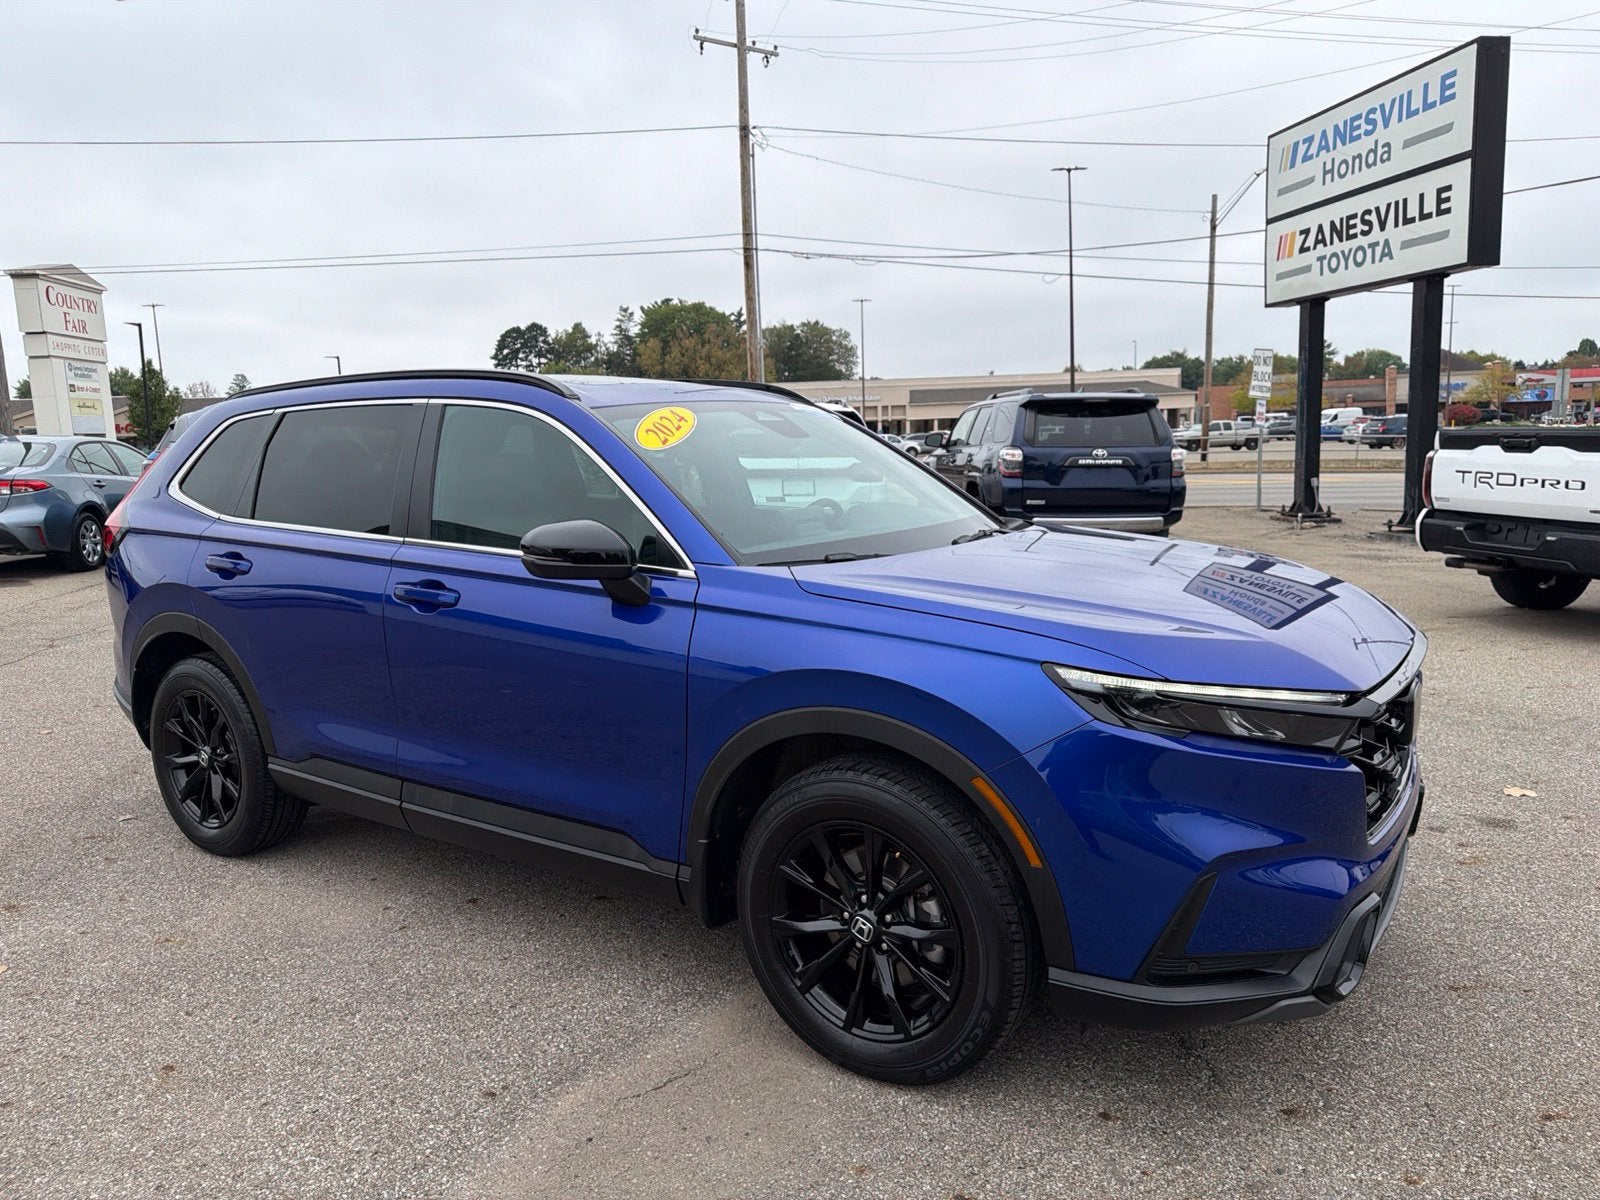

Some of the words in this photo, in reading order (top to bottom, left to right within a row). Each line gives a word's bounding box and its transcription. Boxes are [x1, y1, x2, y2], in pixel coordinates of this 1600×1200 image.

[1301, 68, 1457, 164] ZANESVILLE
[1322, 139, 1392, 186] Honda
[1298, 183, 1453, 255] ZANESVILLE
[1316, 238, 1394, 276] TOYOTA
[52, 340, 81, 354] SHOPPING
[83, 345, 105, 357] CENTER
[645, 409, 689, 446] 2024
